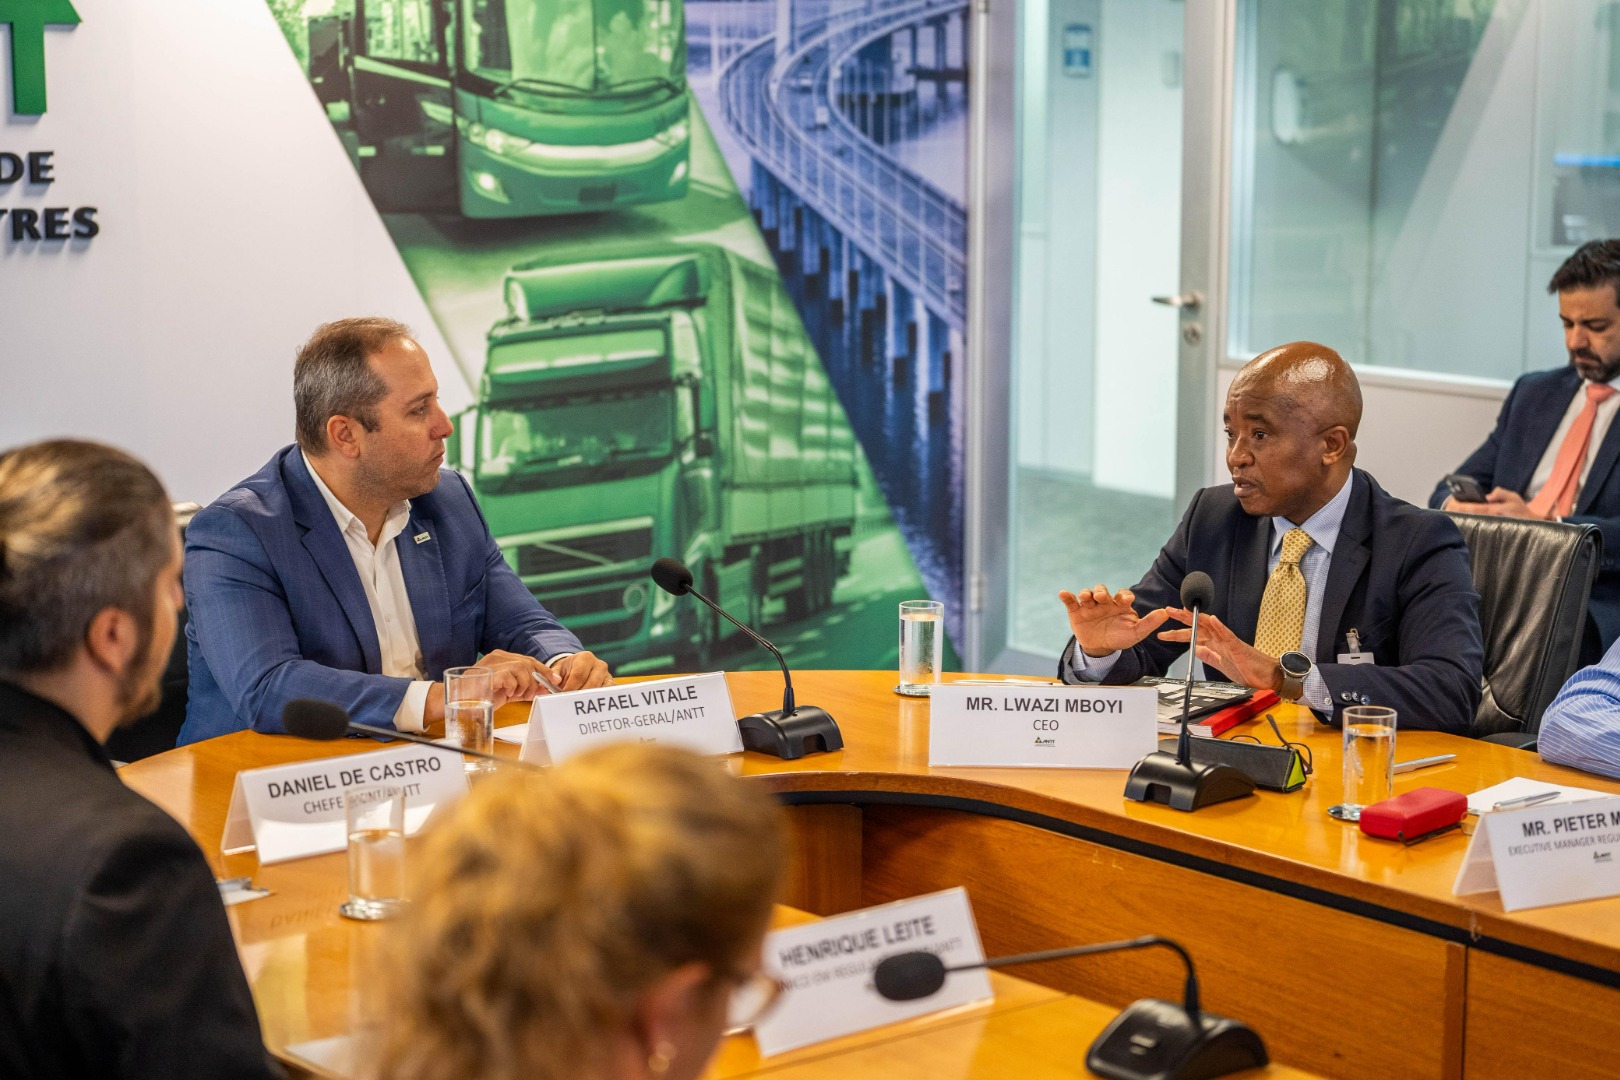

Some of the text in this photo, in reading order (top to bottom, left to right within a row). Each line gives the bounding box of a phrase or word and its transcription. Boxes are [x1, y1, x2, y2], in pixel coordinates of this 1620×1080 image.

[0, 206, 100, 241] RES
[574, 685, 698, 716] RAFAEL VITALE
[966, 697, 1122, 714] MR. LWAZI MBOYI
[579, 706, 705, 735] DIRETOR-GERAL/ANTT
[1033, 719, 1059, 731] CEO
[268, 756, 441, 798] DANIEL DE CASTRO
[304, 796, 344, 815] CHEFE
[1522, 820, 1551, 837] MR.
[1554, 813, 1607, 834] PIETER
[1508, 841, 1552, 856] EXECUTIVE
[1554, 835, 1595, 849] MANAGER
[778, 927, 879, 968] HENRIQUE
[882, 915, 936, 944] LEITE
